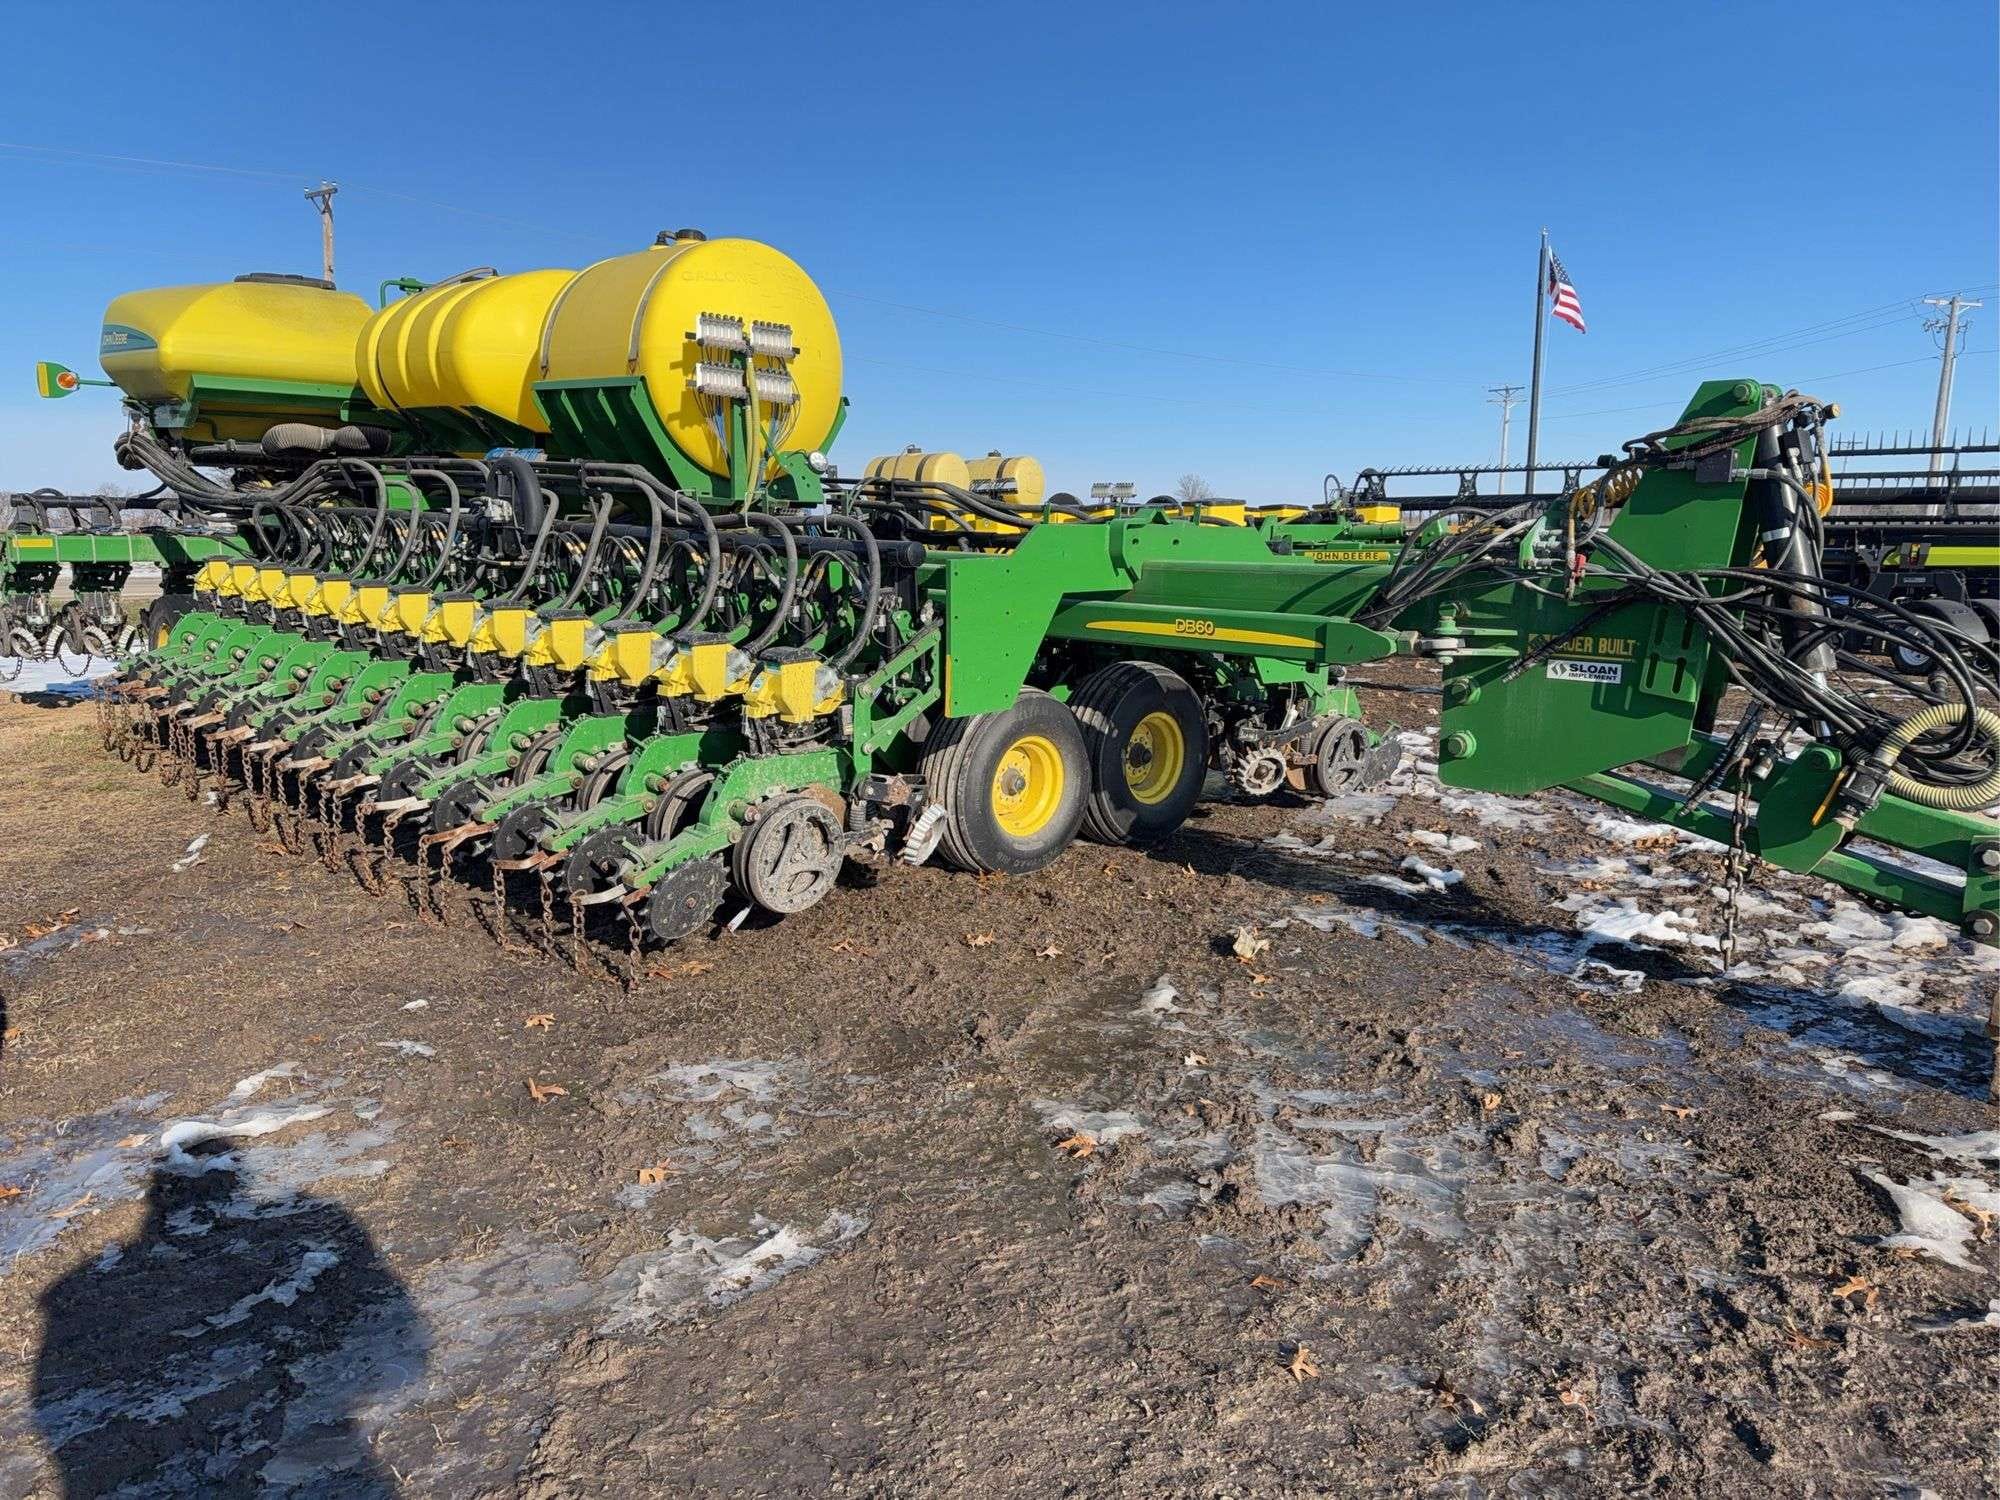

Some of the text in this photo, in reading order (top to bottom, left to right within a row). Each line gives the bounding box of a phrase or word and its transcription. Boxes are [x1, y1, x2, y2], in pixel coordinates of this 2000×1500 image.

[1343, 552, 1378, 560] DEERE
[1175, 619, 1214, 635] DB60
[1598, 637, 1636, 656] BUILT
[1569, 663, 1618, 675] SLOAN
[1568, 672, 1617, 681] IMPLEMENT
